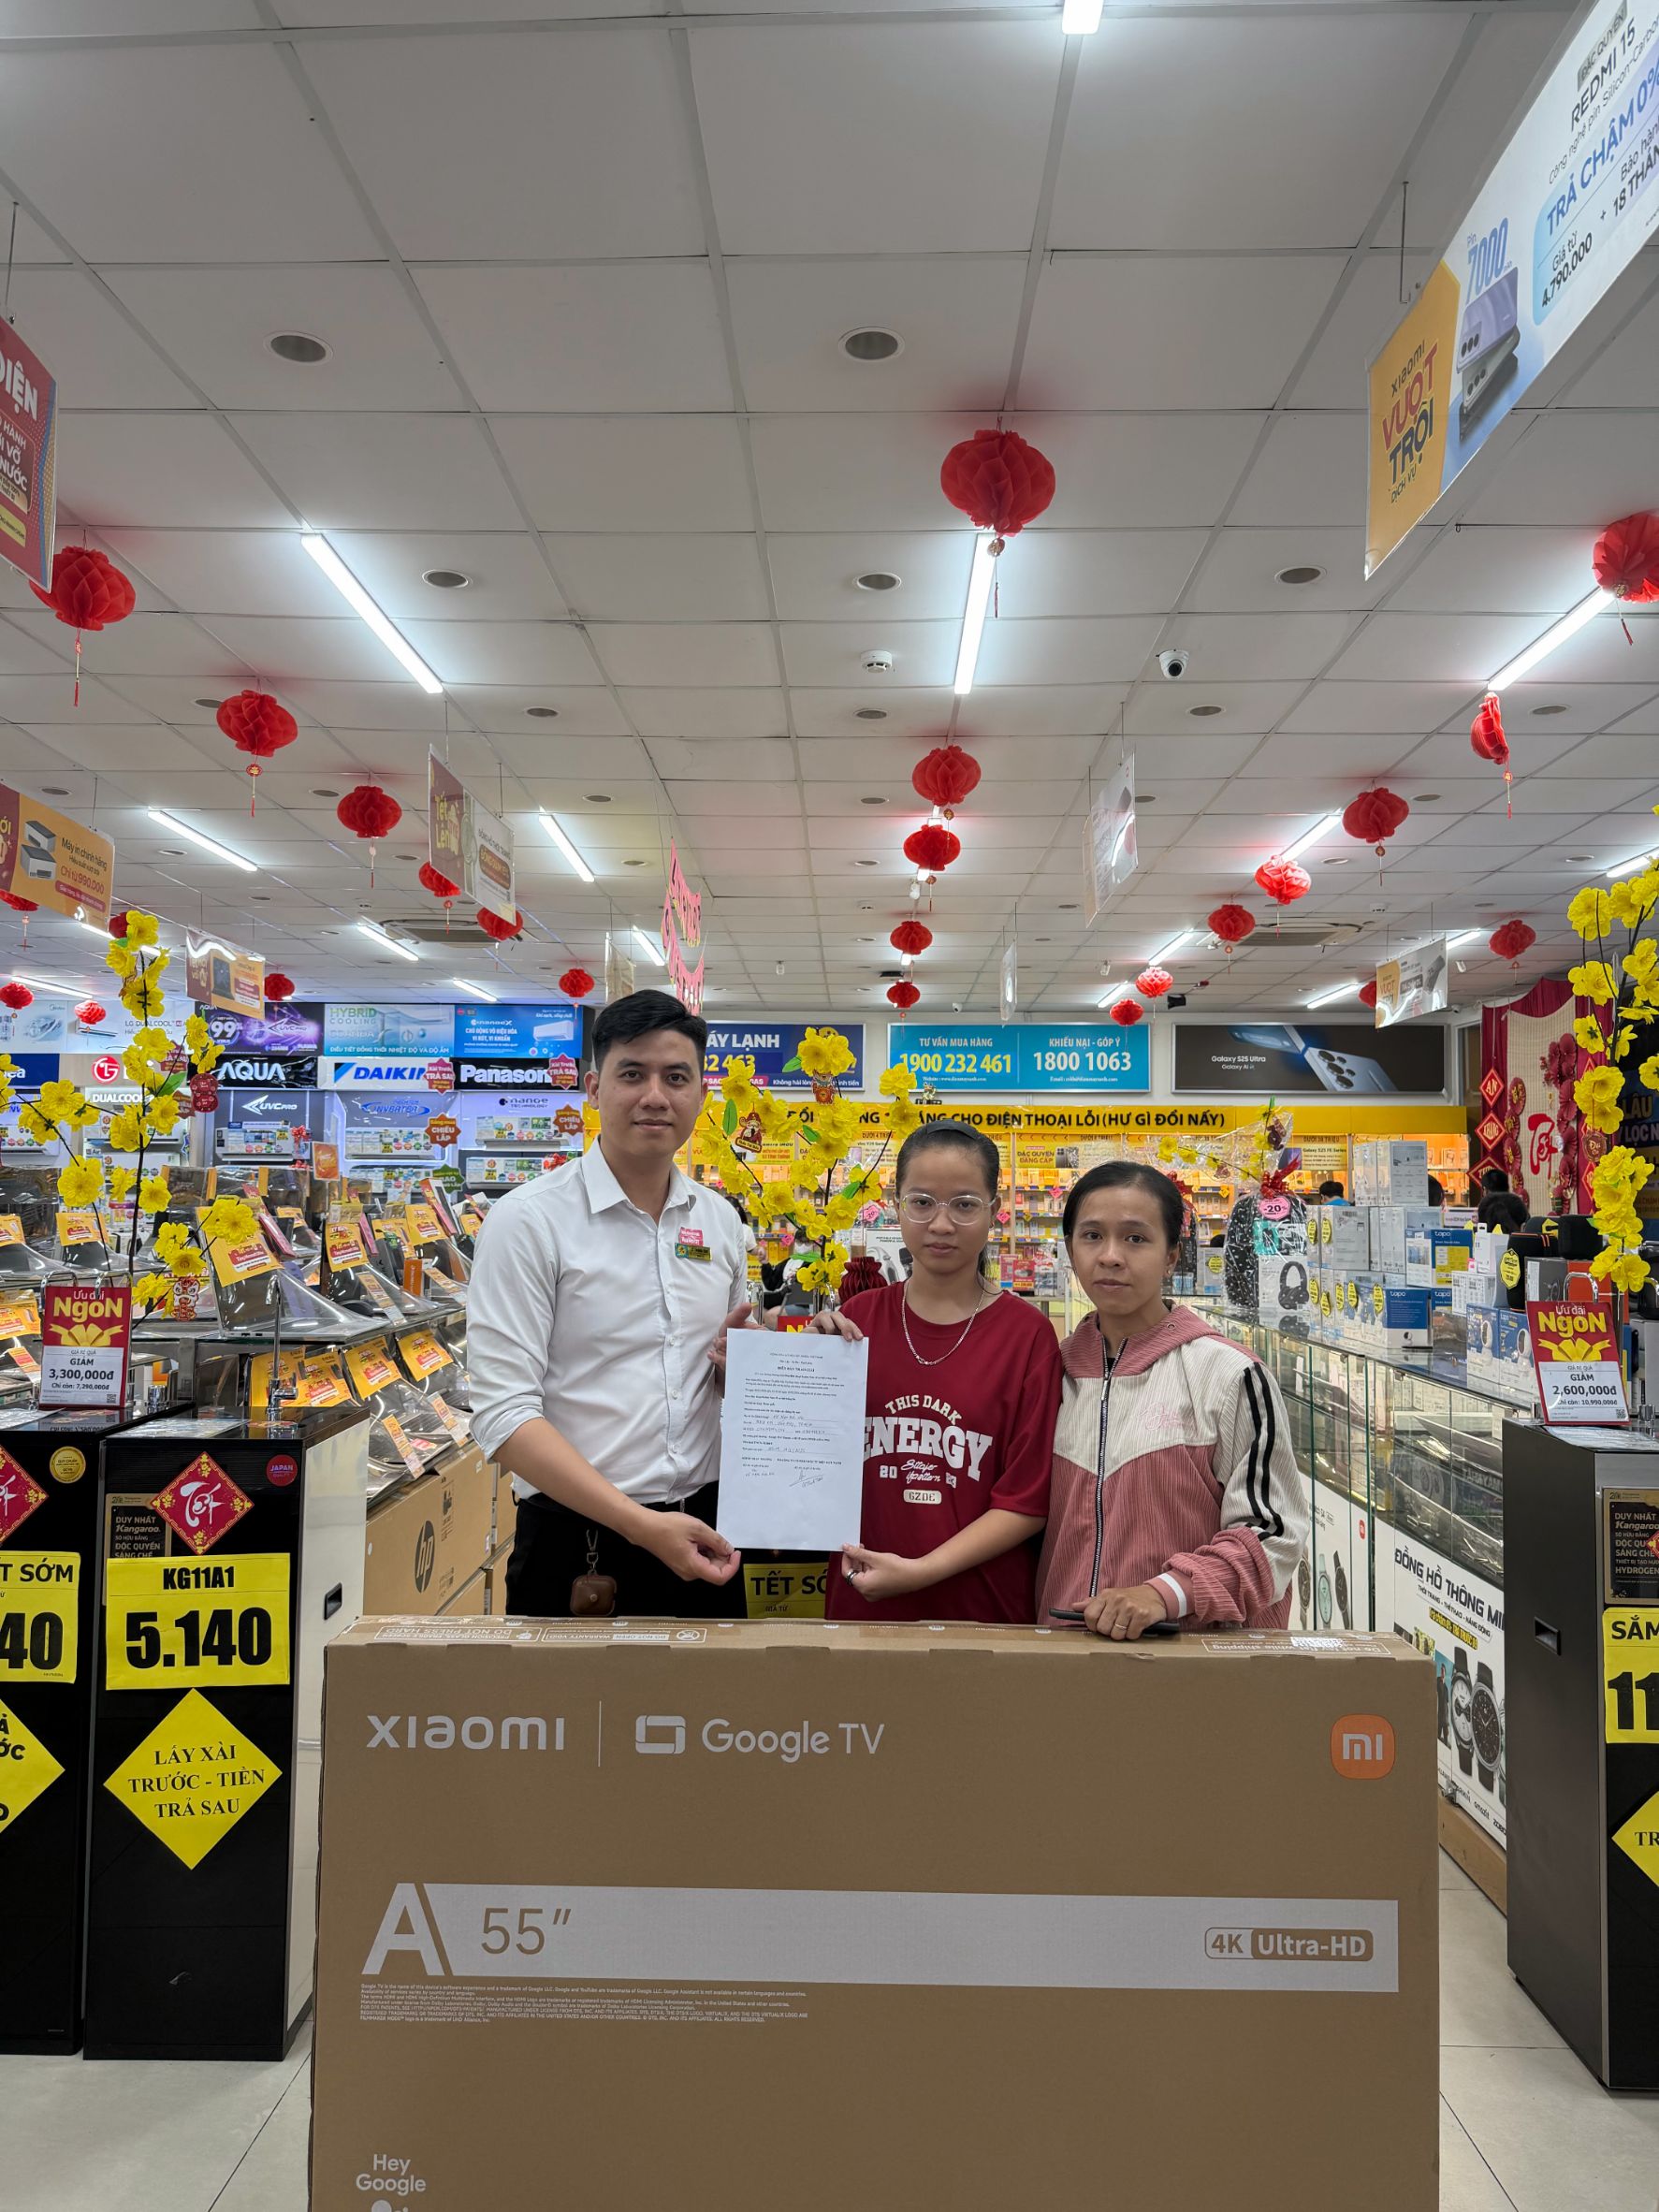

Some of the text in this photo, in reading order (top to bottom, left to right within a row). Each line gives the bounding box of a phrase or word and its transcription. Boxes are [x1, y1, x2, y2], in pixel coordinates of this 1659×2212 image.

[1571, 17, 1636, 132] REDMI 15
[1550, 153, 1567, 184] Công
[1588, 105, 1601, 133] pin
[1546, 172, 1578, 237] TRẢ
[1580, 97, 1634, 189] CHẬM
[1621, 150, 1637, 182] Bảo
[1613, 188, 1626, 217] 18
[1465, 217, 1508, 306] 7000
[1552, 230, 1578, 271] Giá từ
[1541, 232, 1593, 307] 4.790.000
[1382, 342, 1437, 451] VƯỢT
[1390, 397, 1434, 485] TRỘI
[62, 837, 75, 854] Máy
[329, 1008, 376, 1018] HYBRID
[706, 1030, 780, 1051] ÁY LẠNH
[920, 1036, 993, 1047] TƯ VẤN MUA HÀNG
[1049, 1035, 1121, 1049] KHIẾU NẠI GÓP Ý
[217, 1062, 285, 1081] AQUA
[899, 1054, 1011, 1073] 1900 232 461
[1033, 1052, 1131, 1071] 1800 1063
[460, 1065, 552, 1084] Panason
[773, 1079, 792, 1087] Không
[1486, 1081, 1498, 1095] AN
[1623, 1093, 1652, 1119] LÂU
[952, 1110, 1225, 1128] CHO ĐIỆN THOẠI LỖI (HƯ GÌ ĐỔI NẤY)
[1625, 1125, 1649, 1146] LỌC
[73, 1290, 85, 1300] Ưu
[53, 1297, 123, 1322] NgoN
[1556, 1304, 1586, 1316] Ưu đãi
[1537, 1312, 1607, 1338] NgoN
[69, 1356, 94, 1365] GIẢM
[49, 1368, 114, 1380] 3,300,000đ
[1570, 1372, 1594, 1381] GIẢM
[1552, 1385, 1617, 1396] 2,600,000đ
[885, 1394, 962, 1425] THIS DARK
[864, 1416, 993, 1482] ENERGY
[880, 1465, 897, 1478] 20
[134, 1515, 156, 1523] NHẤT
[1615, 1511, 1656, 1521] DUY NHẤT
[133, 1541, 160, 1550] QUYỀN
[1615, 1538, 1632, 1547] ĐỘC
[1615, 1548, 1637, 1557] SÁNG
[20, 1559, 74, 1583] SỚM
[163, 1565, 235, 1590] KG11A1
[750, 1568, 827, 1595] TẾT SỚ
[1395, 1545, 1424, 1579] ĐỒNG
[1426, 1564, 1442, 1591] HỒ
[1446, 1579, 1485, 1619] THÔNG
[125, 1607, 272, 1669] 5.140
[366, 1714, 565, 1751] xiaomi
[702, 1718, 885, 1763] Google TV
[153, 1741, 237, 1767] LẤY XÀI
[128, 1767, 265, 1794] TRƯỚC TIỀN
[154, 1797, 240, 1819] TRẢ SAU
[361, 1883, 445, 1975] A
[1211, 1933, 1366, 1957] 4K Ultra-HD
[373, 2154, 411, 2176] Hey
[356, 2173, 427, 2197] Google
